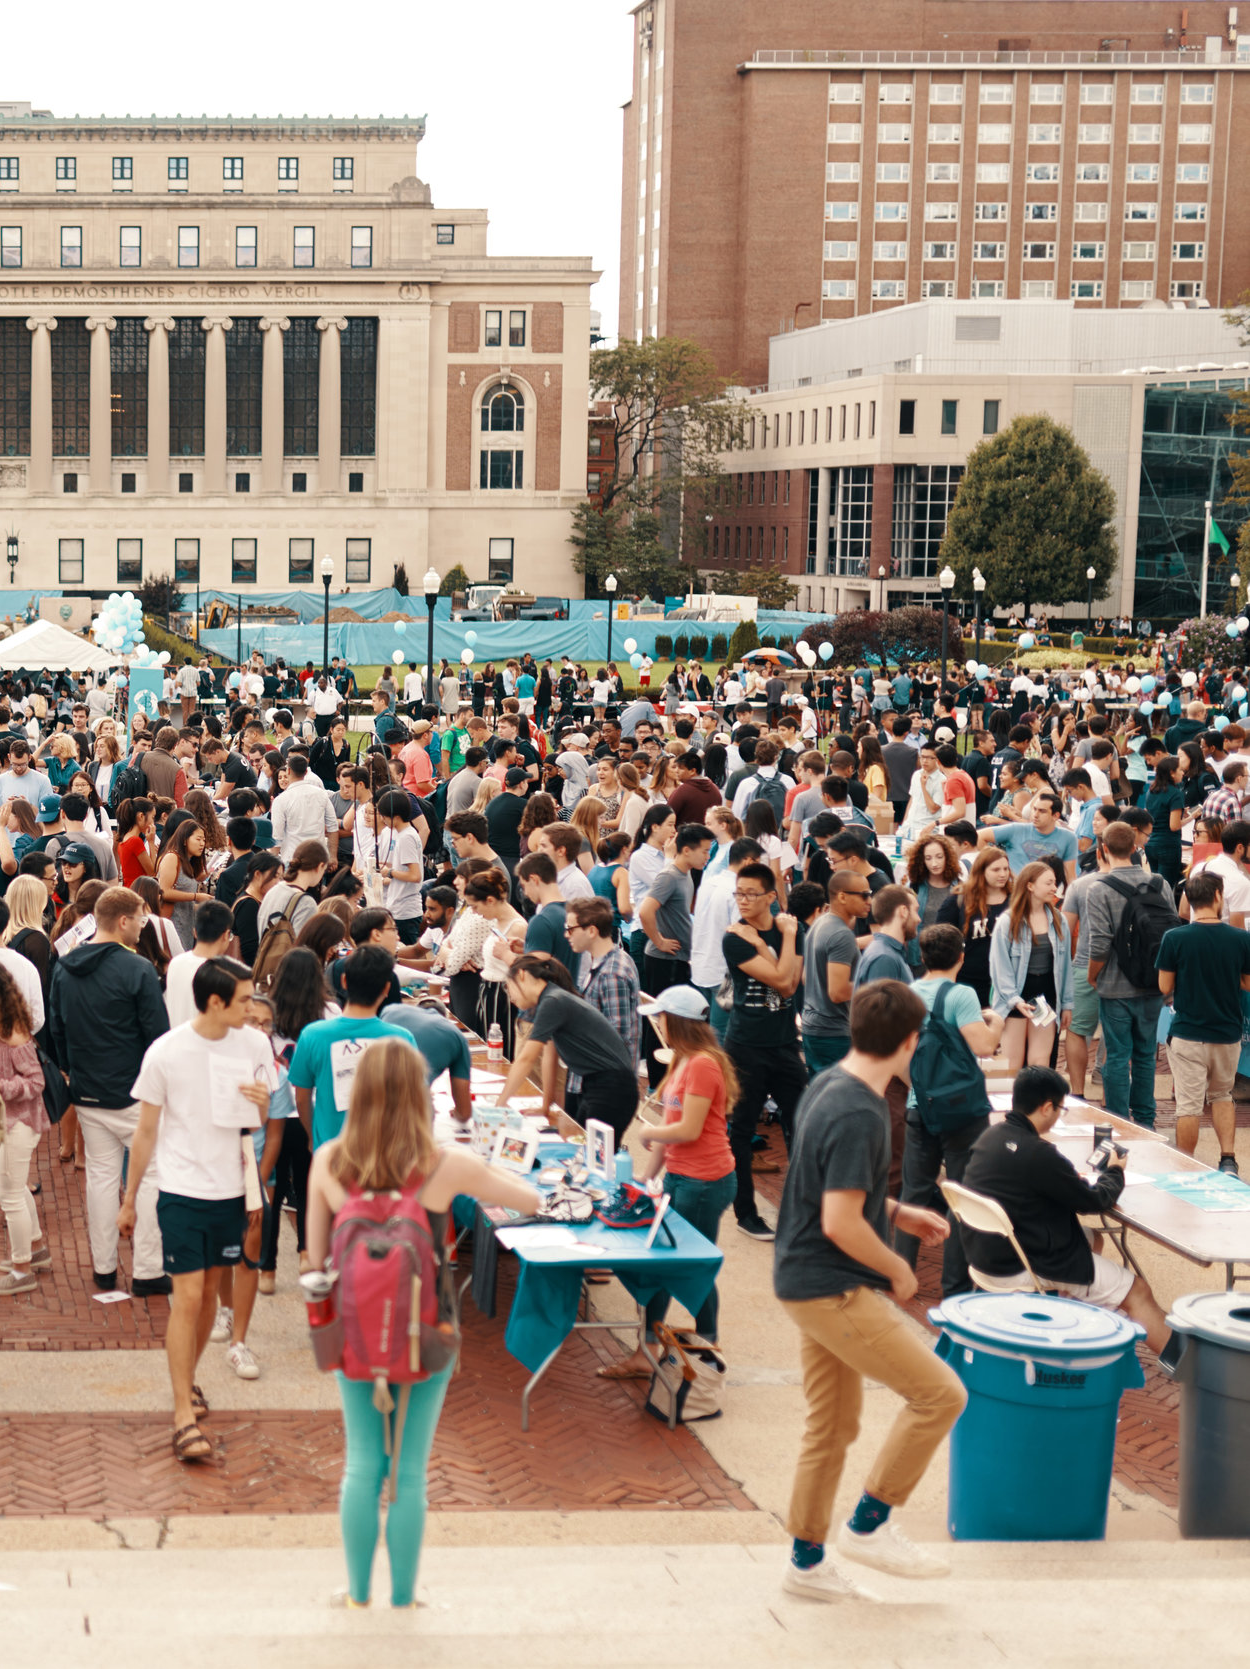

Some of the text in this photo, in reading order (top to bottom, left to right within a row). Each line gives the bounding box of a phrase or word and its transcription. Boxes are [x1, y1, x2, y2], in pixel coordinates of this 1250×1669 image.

[52, 287, 175, 298] DEMOSTHENES
[187, 287, 250, 298] CICERO
[262, 287, 322, 298] VERGIL
